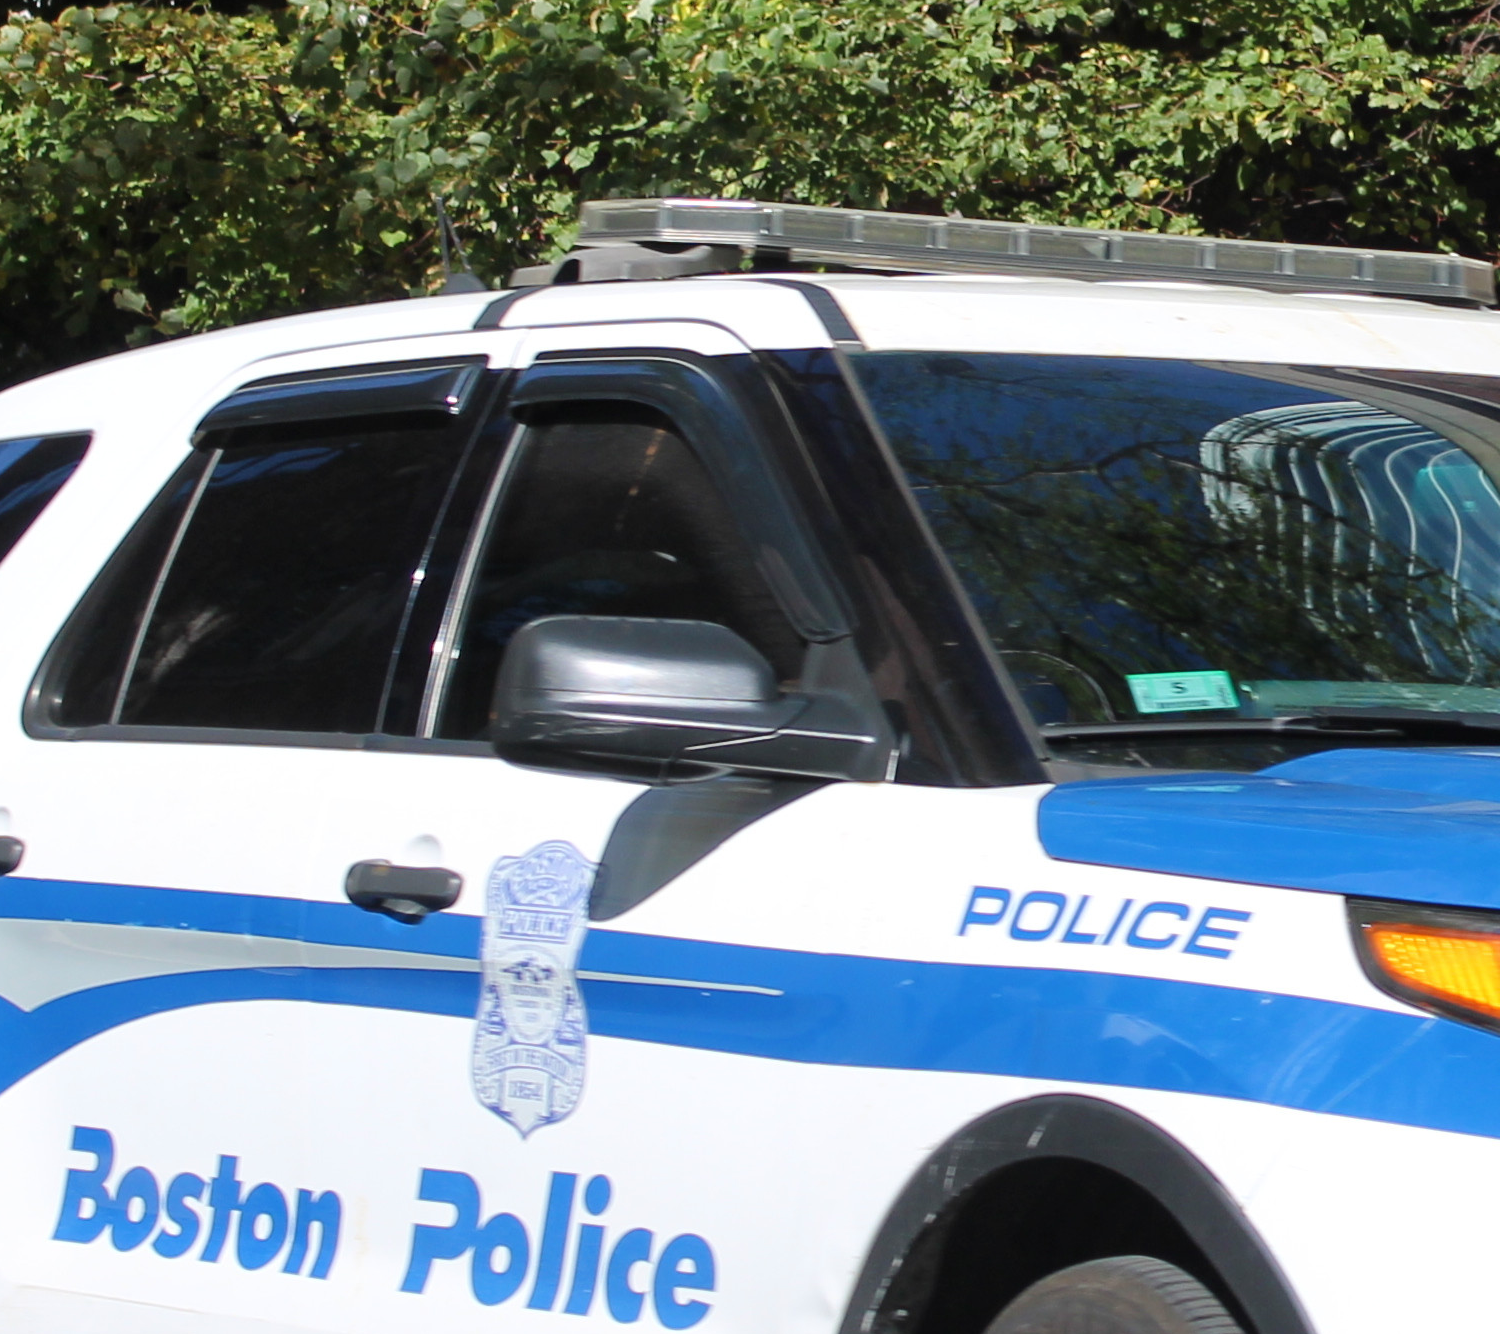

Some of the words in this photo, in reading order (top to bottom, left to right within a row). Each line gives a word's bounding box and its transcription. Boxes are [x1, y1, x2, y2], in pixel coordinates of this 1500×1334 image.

[957, 885, 1253, 959] POLICE
[52, 1125, 344, 1280] Boston
[399, 1167, 717, 1331] Police
